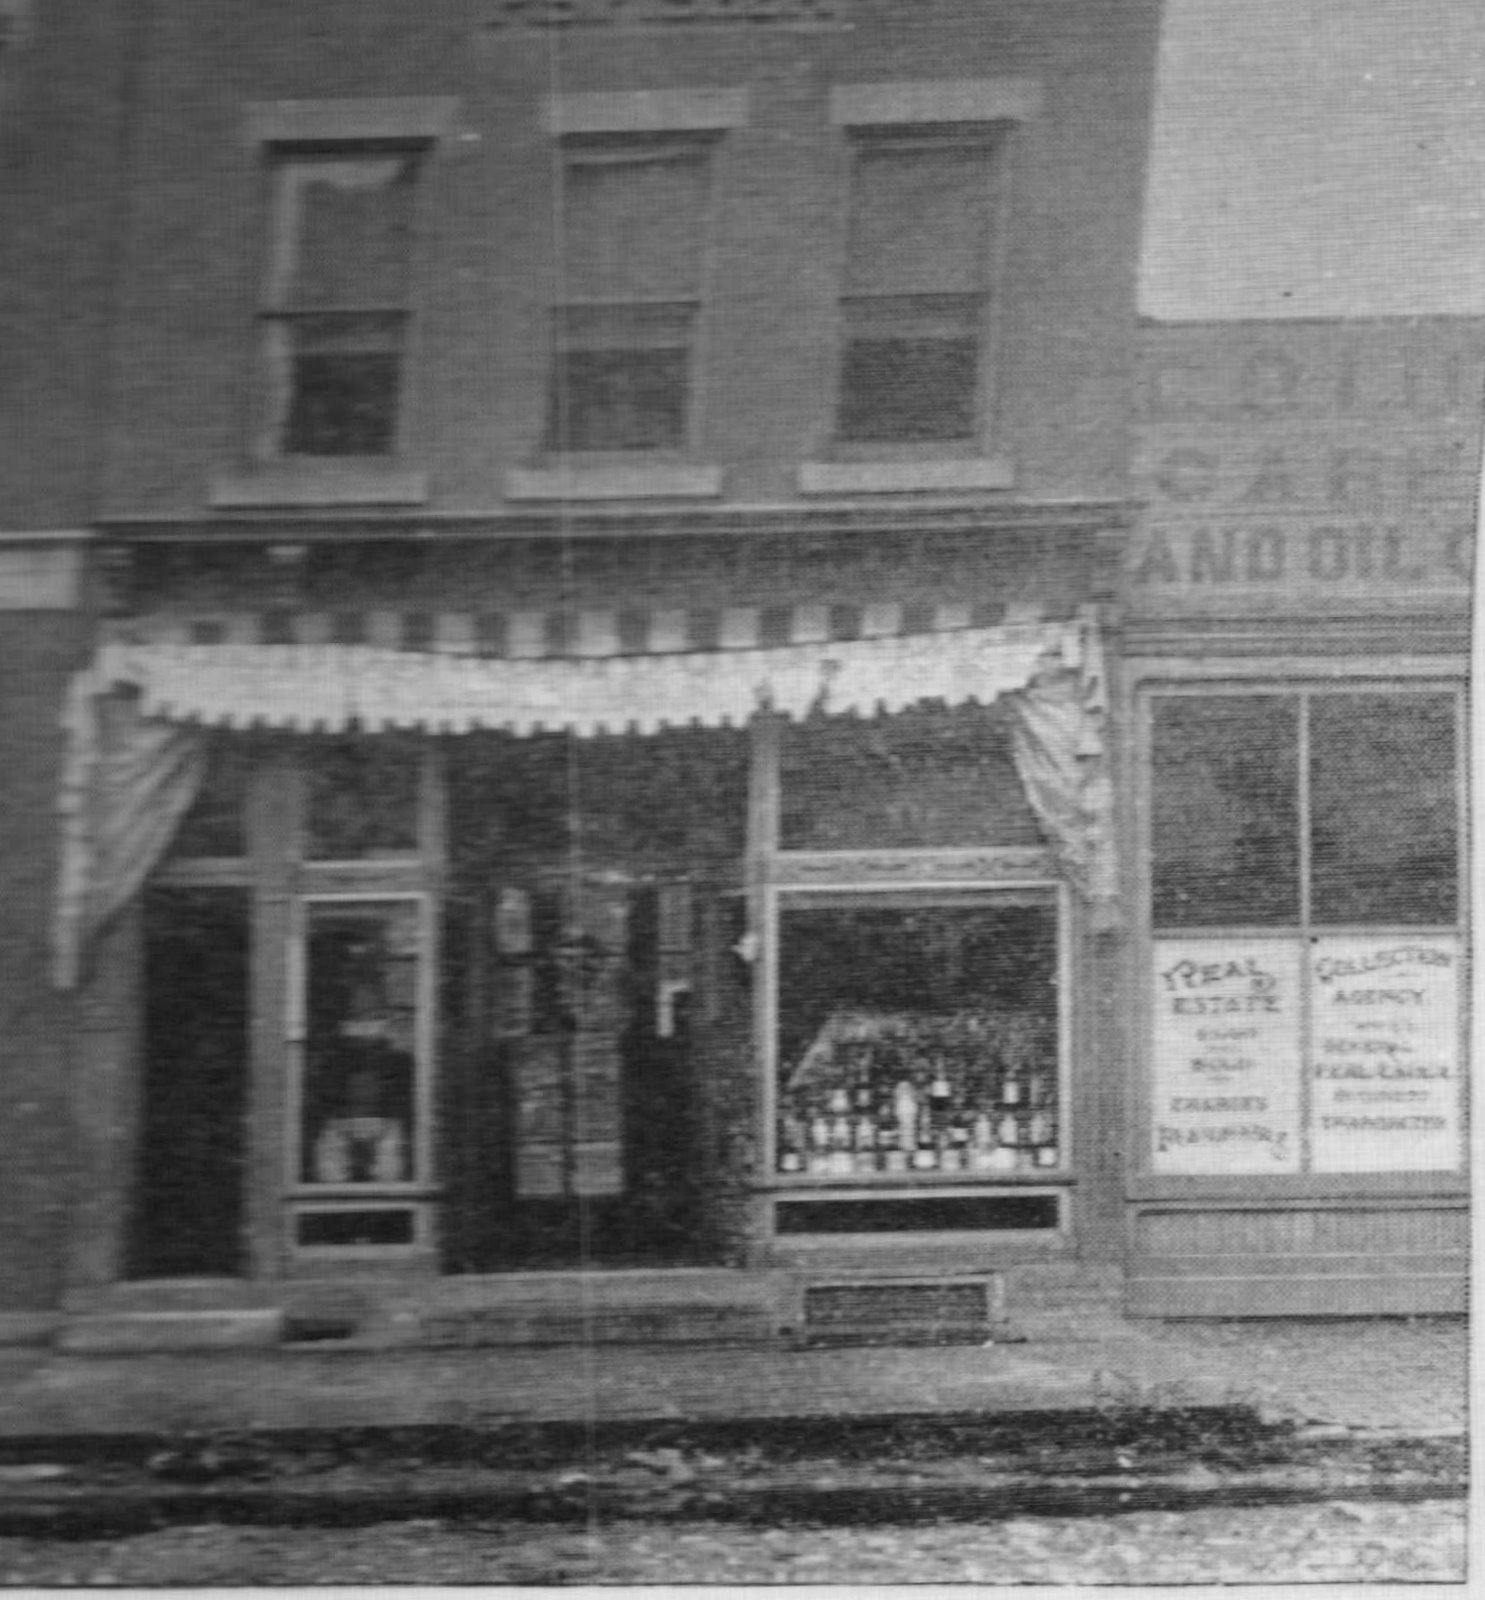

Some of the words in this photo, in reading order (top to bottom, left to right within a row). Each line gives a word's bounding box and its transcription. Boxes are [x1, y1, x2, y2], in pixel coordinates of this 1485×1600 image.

[1132, 526, 1286, 585] AND
[1161, 958, 1277, 994] REAL
[1172, 996, 1282, 1016] ESTATE
[1333, 988, 1425, 1006] AGENCY
